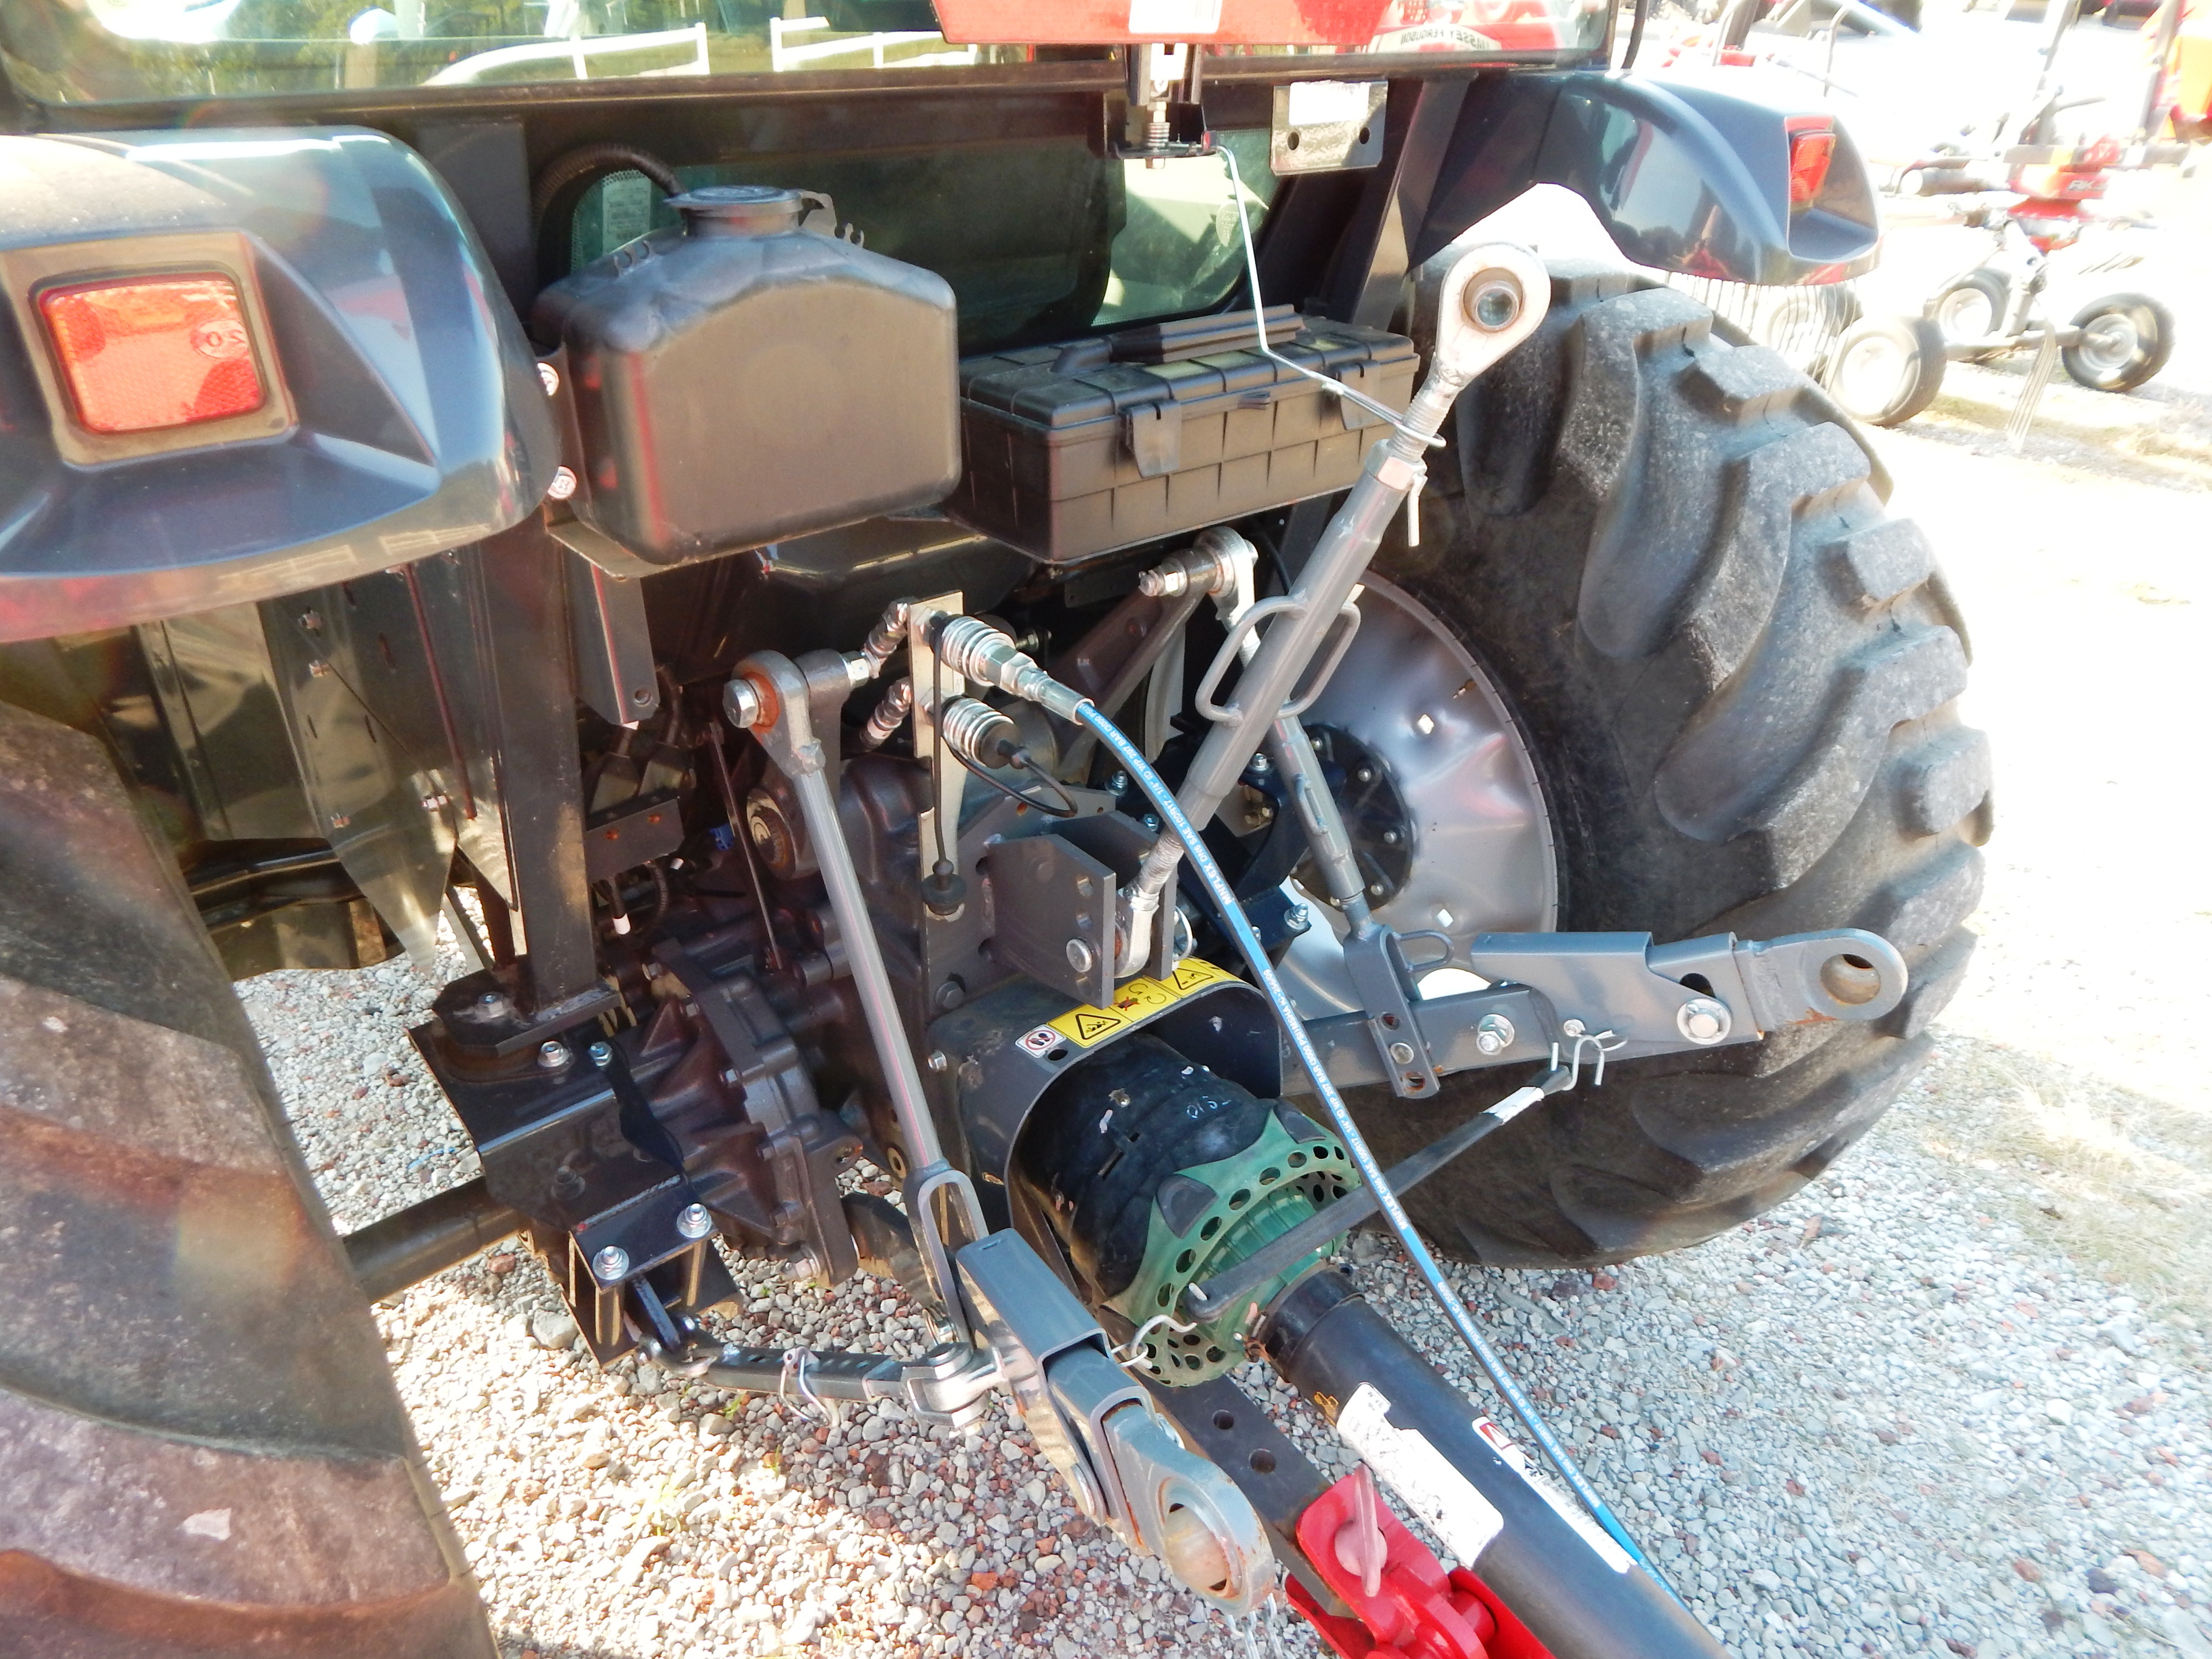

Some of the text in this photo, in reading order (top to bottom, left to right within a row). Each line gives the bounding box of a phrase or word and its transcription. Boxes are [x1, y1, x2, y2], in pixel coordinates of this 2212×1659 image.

[1109, 729, 1127, 747] BAR
[1122, 743, 1137, 759] 207
[1133, 757, 1147, 772] WP
[1163, 798, 1186, 829] 100R17
[1182, 826, 1198, 845] SAE
[1313, 1065, 1327, 1083] BAR
[1322, 1082, 1334, 1097] 207
[1329, 1095, 1341, 1109] WP
[1350, 1136, 1370, 1163] 100R17
[1364, 1161, 1379, 1178] SAE
[1490, 1360, 1505, 1377] BAR
[1500, 1375, 1513, 1389] 207
[1550, 1443, 1565, 1461] SAE
